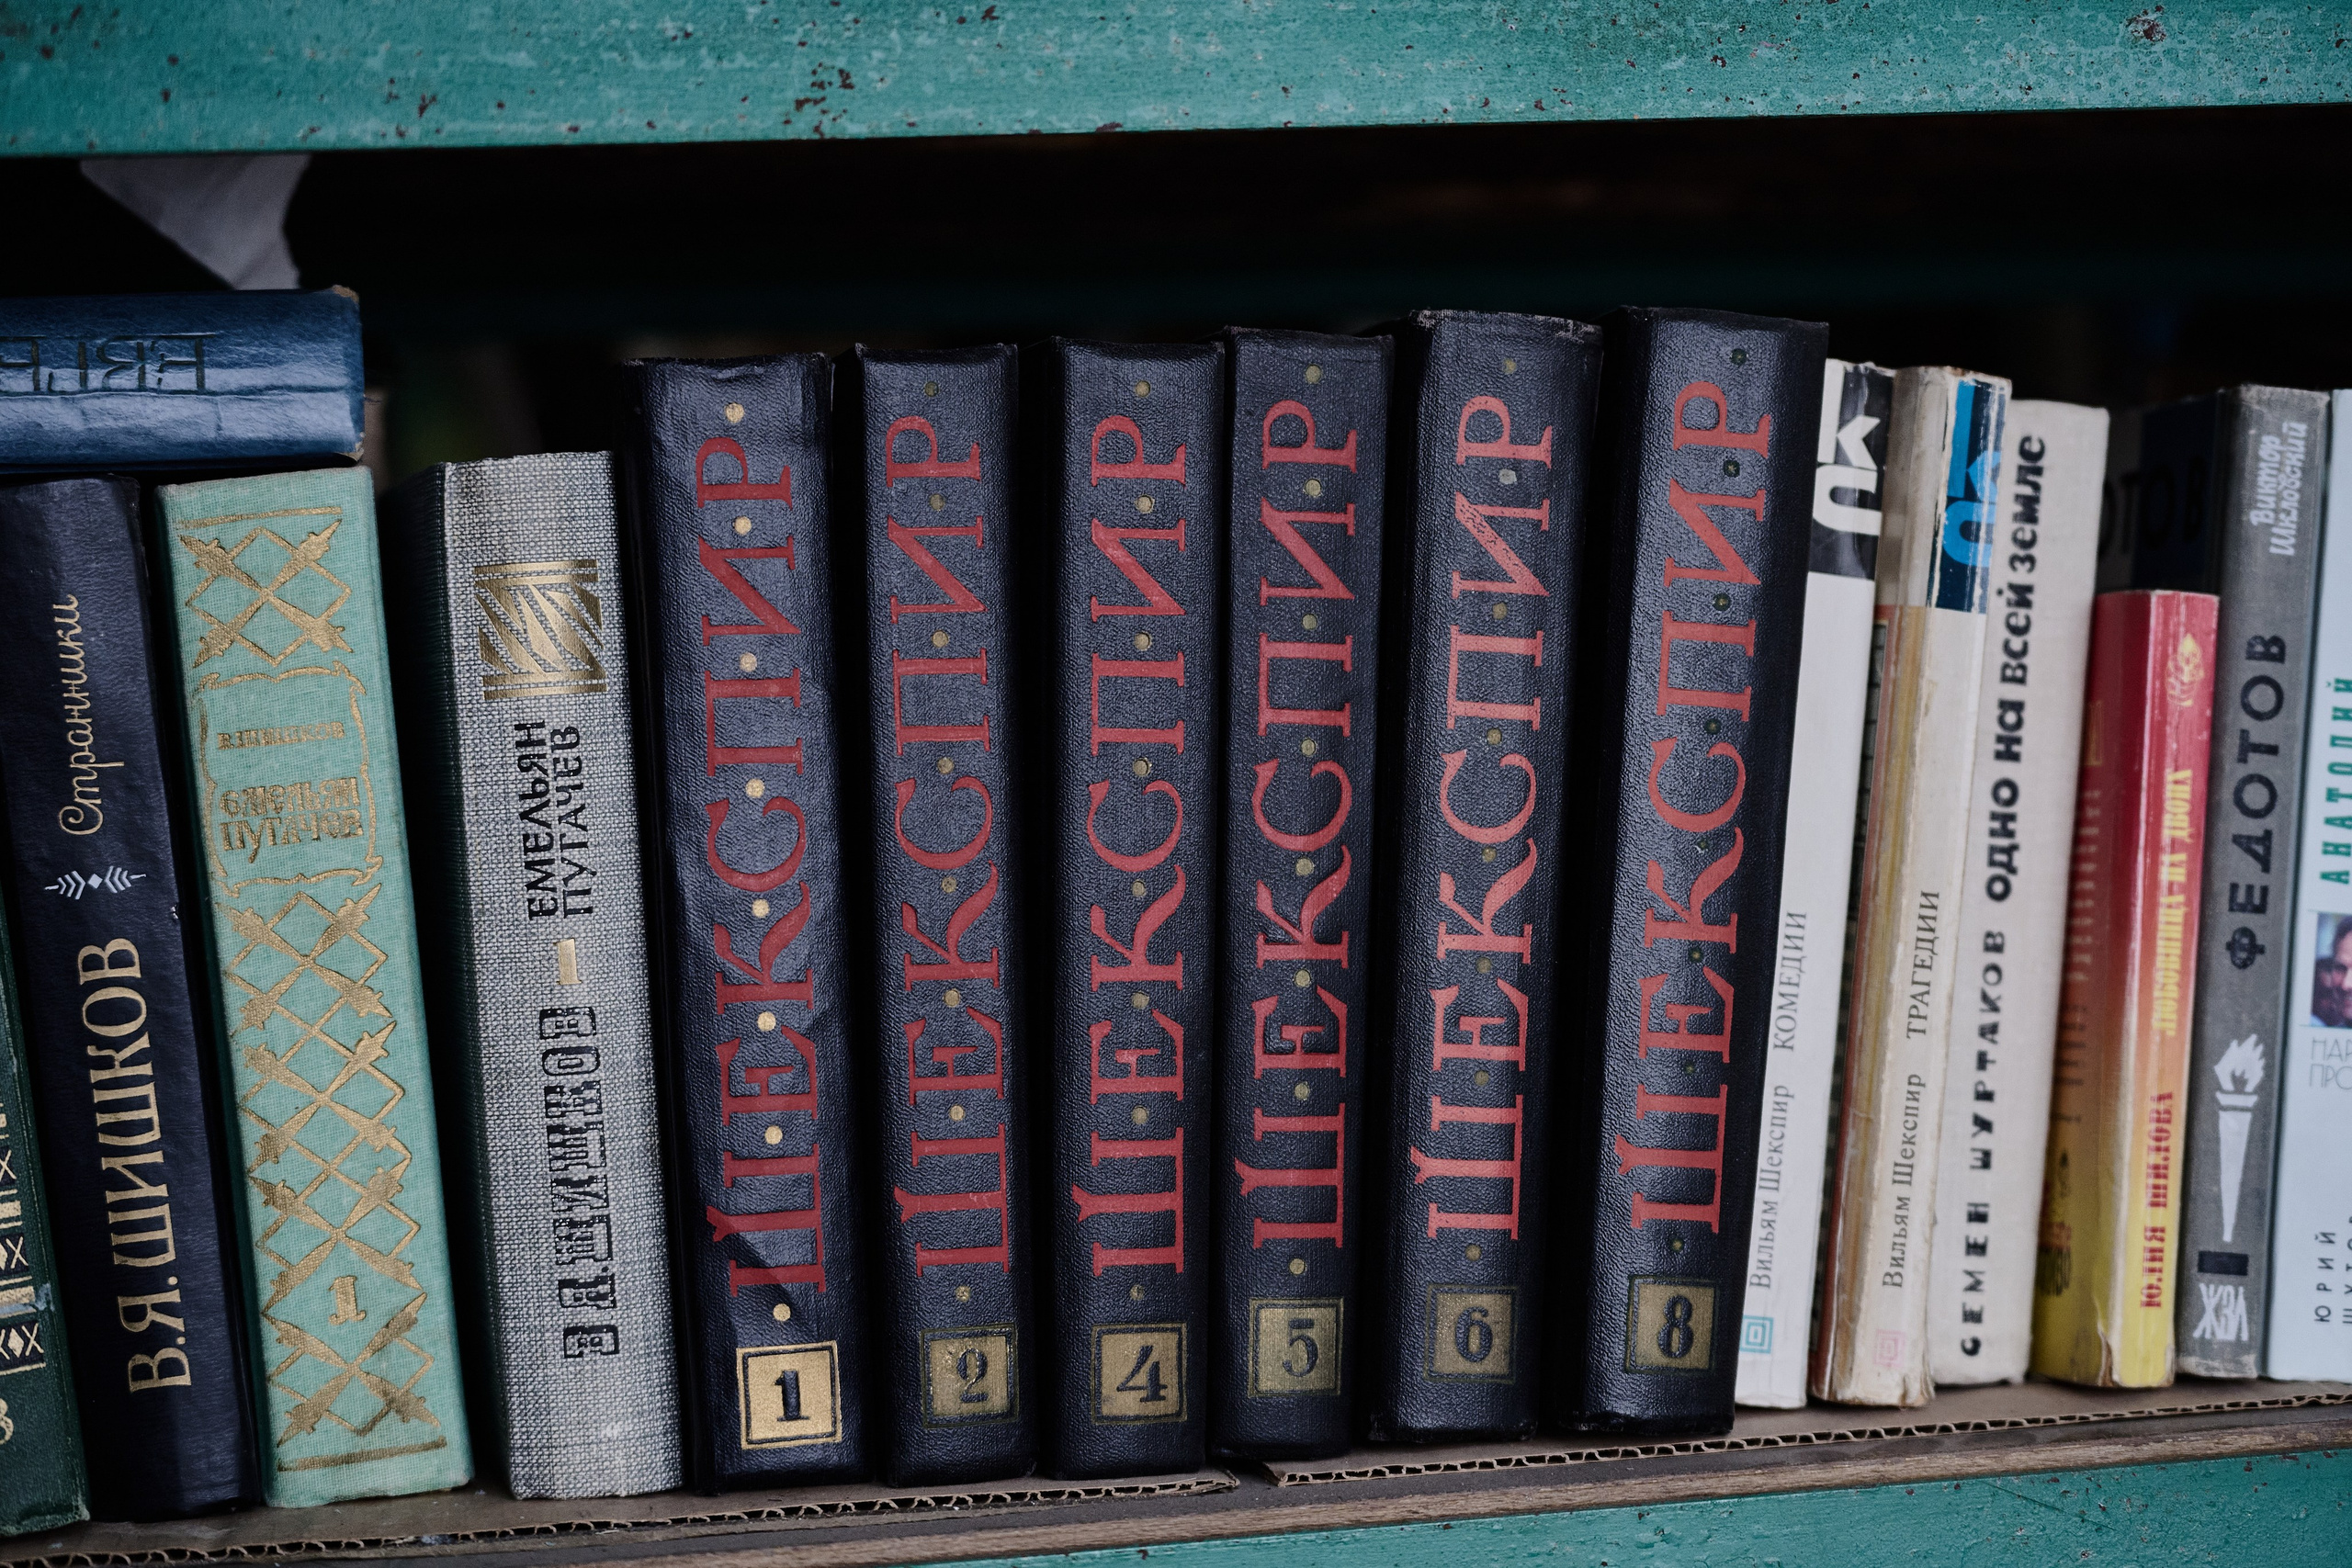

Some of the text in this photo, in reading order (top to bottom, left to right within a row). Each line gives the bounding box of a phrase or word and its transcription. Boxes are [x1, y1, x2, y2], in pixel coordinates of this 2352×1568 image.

[2250, 434, 2282, 526] Виктор
[2269, 421, 2308, 557] Шкловский
[59, 593, 126, 836] Странники
[514, 720, 560, 919] ЕМЕЛЬЯН
[551, 726, 595, 918] ПУГАЧЕВ
[2225, 633, 2288, 970] ФЕДОТОВ
[2320, 678, 2352, 886] АНАТОЛИЙ
[557, 937, 583, 986] 1
[1748, 909, 1808, 1291] Вильям Шекспир КОМЕДИИ
[1882, 888, 1941, 1290] Вильям Шекспир ТРАГЕДИИ
[1960, 930, 2007, 1358] СЕМЕН ШУРТАКОВ
[2146, 1090, 2175, 1210] ШИЛОВА
[326, 1273, 367, 1326] 1
[2139, 1224, 2168, 1309] ЮЛИЯ
[2191, 1282, 2250, 1342] ЖЗЛ
[2313, 1231, 2336, 1323] ЮРИЙ
[1282, 1317, 1318, 1378] 5
[1454, 1305, 1493, 1362] 6
[1657, 1294, 1694, 1359] 8
[773, 1369, 808, 1422] 1
[956, 1347, 989, 1404] 2
[1116, 1345, 1168, 1404] 4
